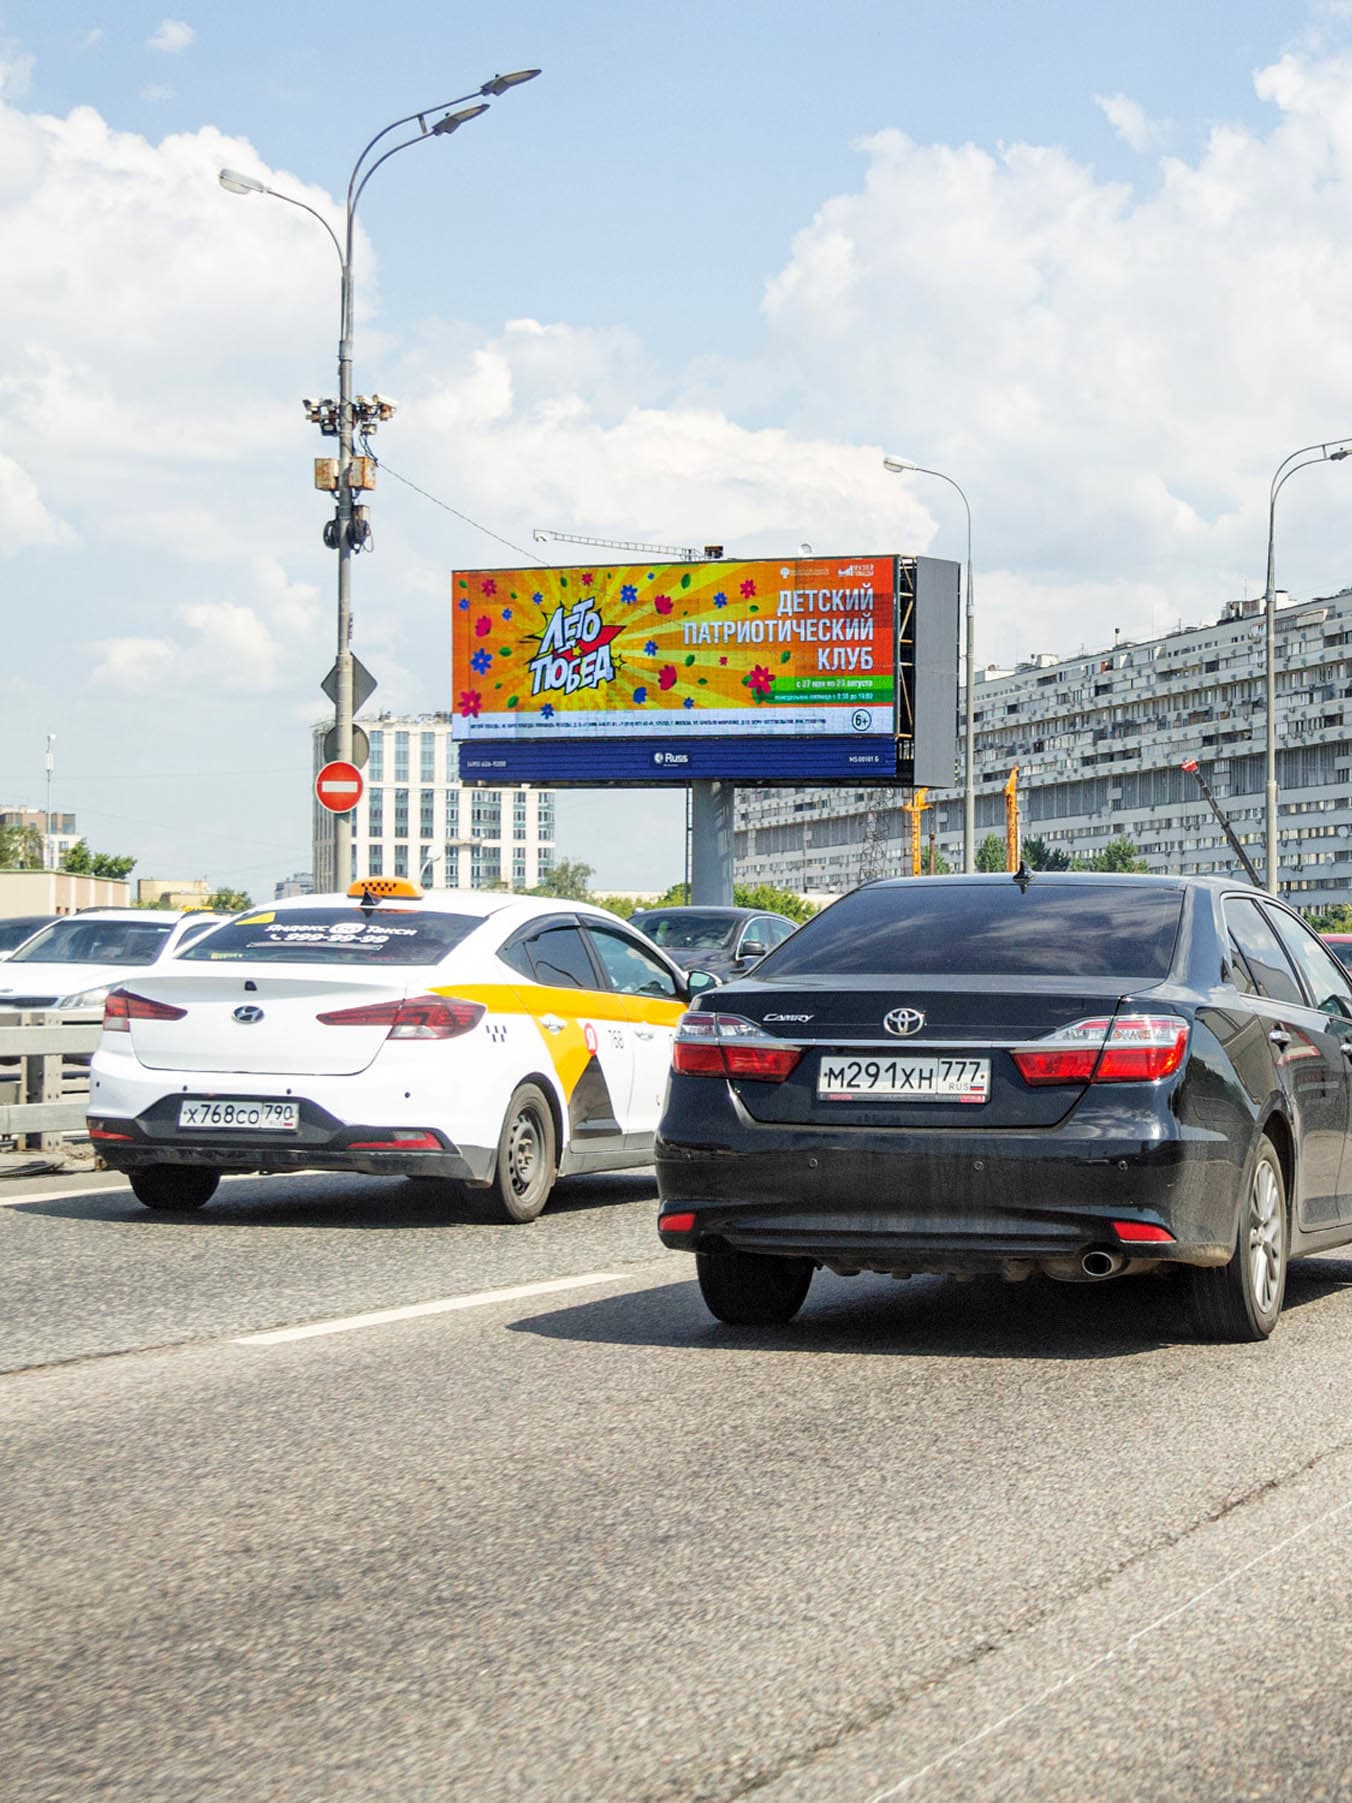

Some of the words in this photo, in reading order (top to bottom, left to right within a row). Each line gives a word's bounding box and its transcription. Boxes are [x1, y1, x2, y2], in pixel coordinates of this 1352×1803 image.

[777, 582, 874, 616] ДЕТСКИЙ
[538, 596, 602, 654] ЛЕТО
[683, 612, 874, 645] ПАТРИОТИЧЕСКИЙ
[817, 646, 874, 671] КЛУБ
[855, 714, 869, 726] 6+
[665, 752, 689, 763] Russ
[285, 932, 390, 944] 999-99-99
[366, 923, 418, 936] Такси
[827, 1061, 934, 1089] М291ХН
[940, 1061, 981, 1083] 777
[949, 1083, 969, 1091] RUS
[264, 1104, 293, 1121] 790
